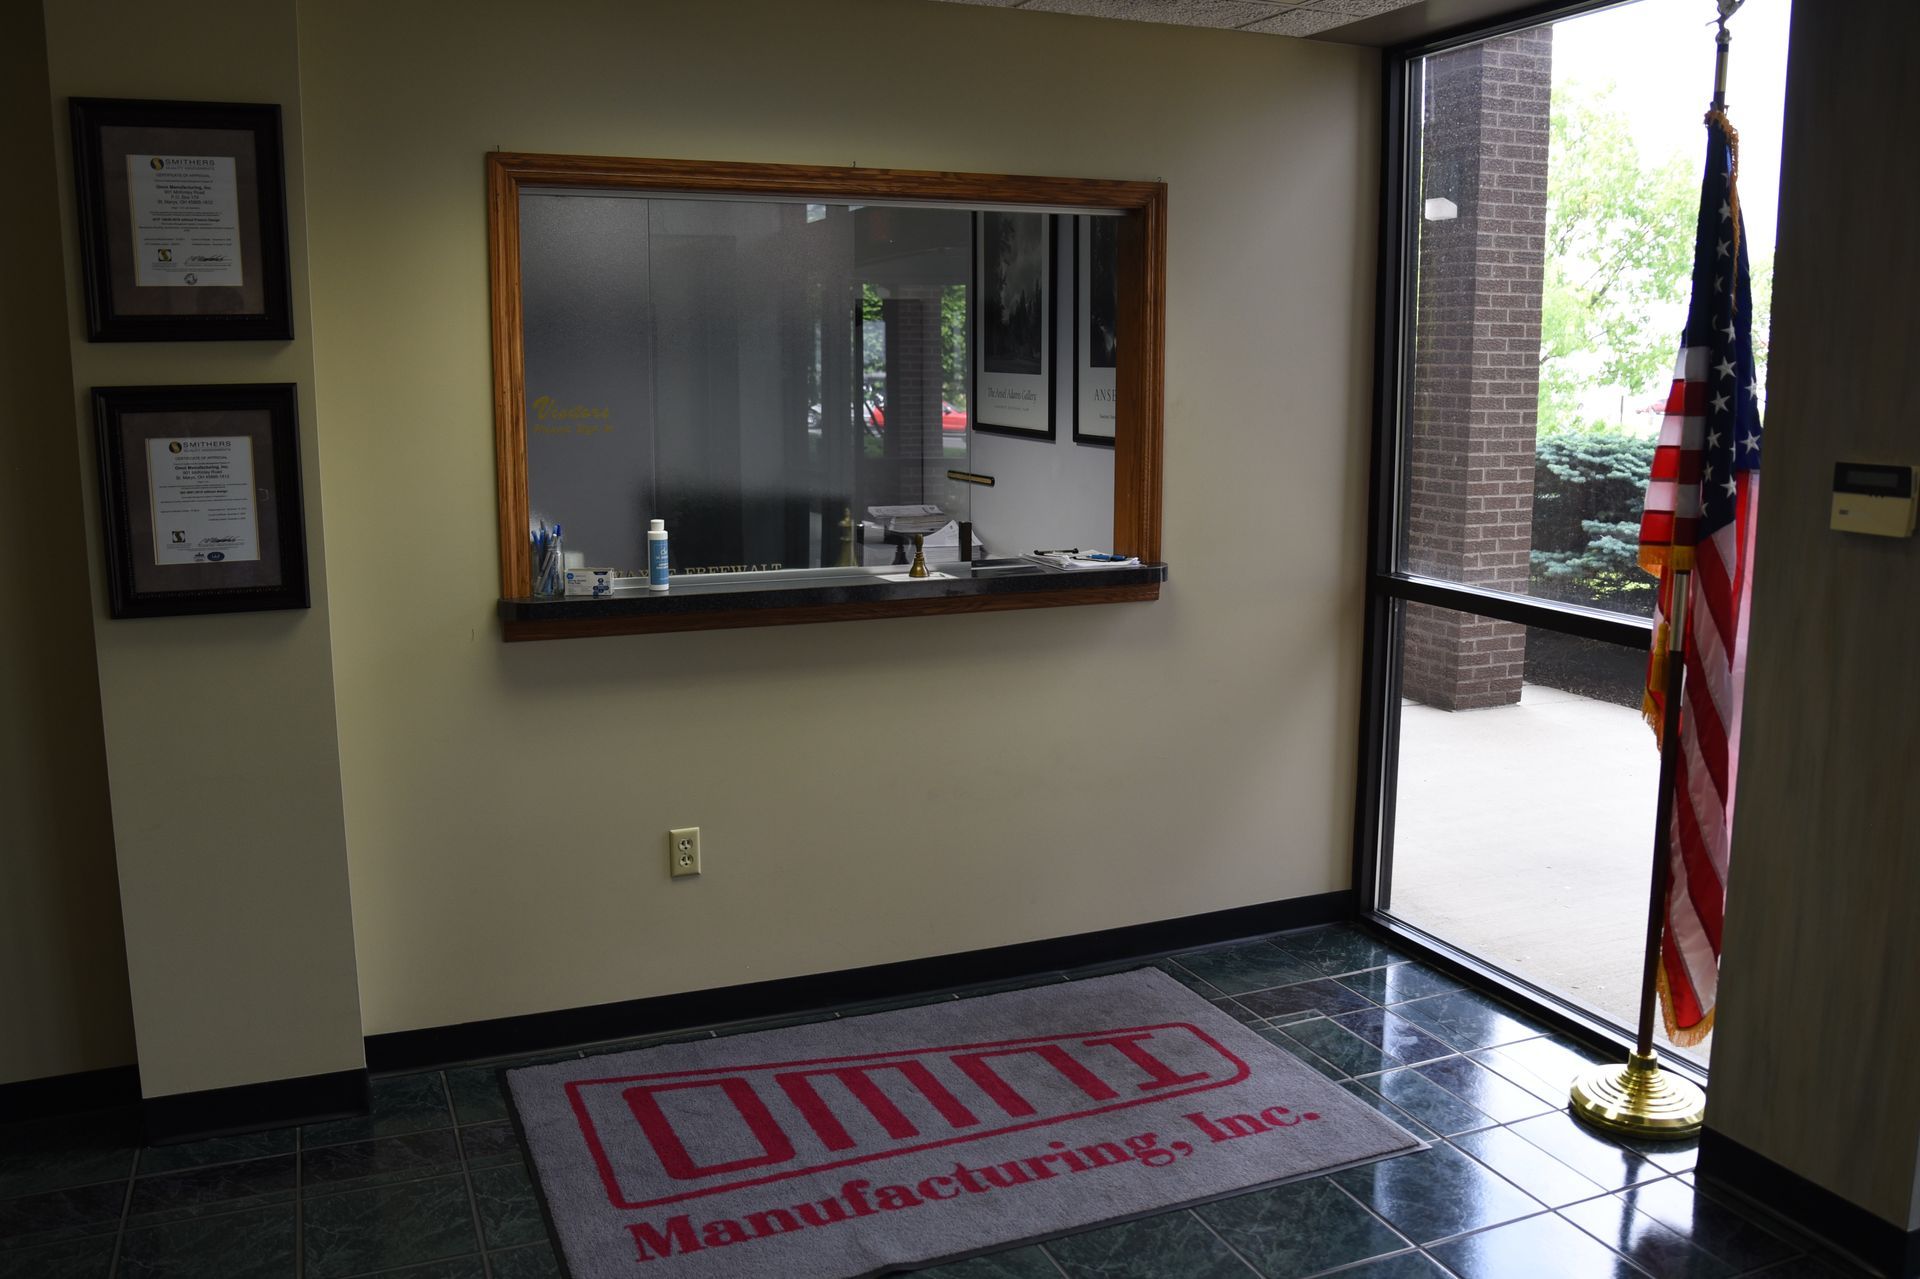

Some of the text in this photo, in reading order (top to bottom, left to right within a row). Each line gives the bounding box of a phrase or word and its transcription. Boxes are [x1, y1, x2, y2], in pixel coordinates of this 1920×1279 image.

[165, 159, 215, 167] SMITHERS
[1007, 387, 1021, 401] Adams
[1022, 389, 1038, 404] Gallery
[624, 1104, 1321, 1263] Manufacturing, Inc.
